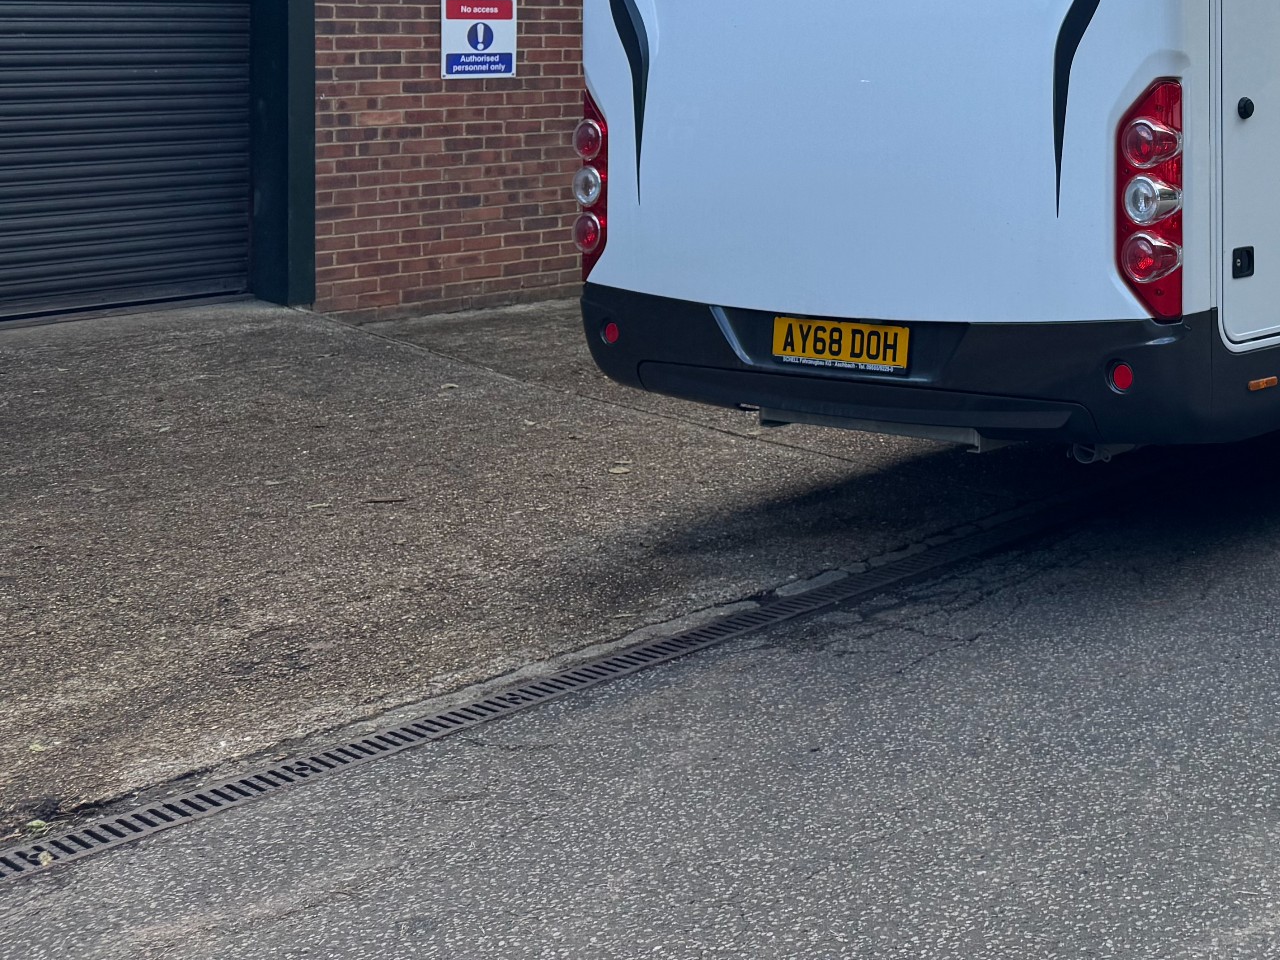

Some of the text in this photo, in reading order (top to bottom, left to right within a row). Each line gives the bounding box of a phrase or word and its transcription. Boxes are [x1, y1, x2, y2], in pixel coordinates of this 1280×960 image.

[461, 5, 472, 13] No
[460, 54, 500, 63] Authorised
[452, 63, 506, 73] personnel only
[782, 323, 899, 362] AY68 DOH
